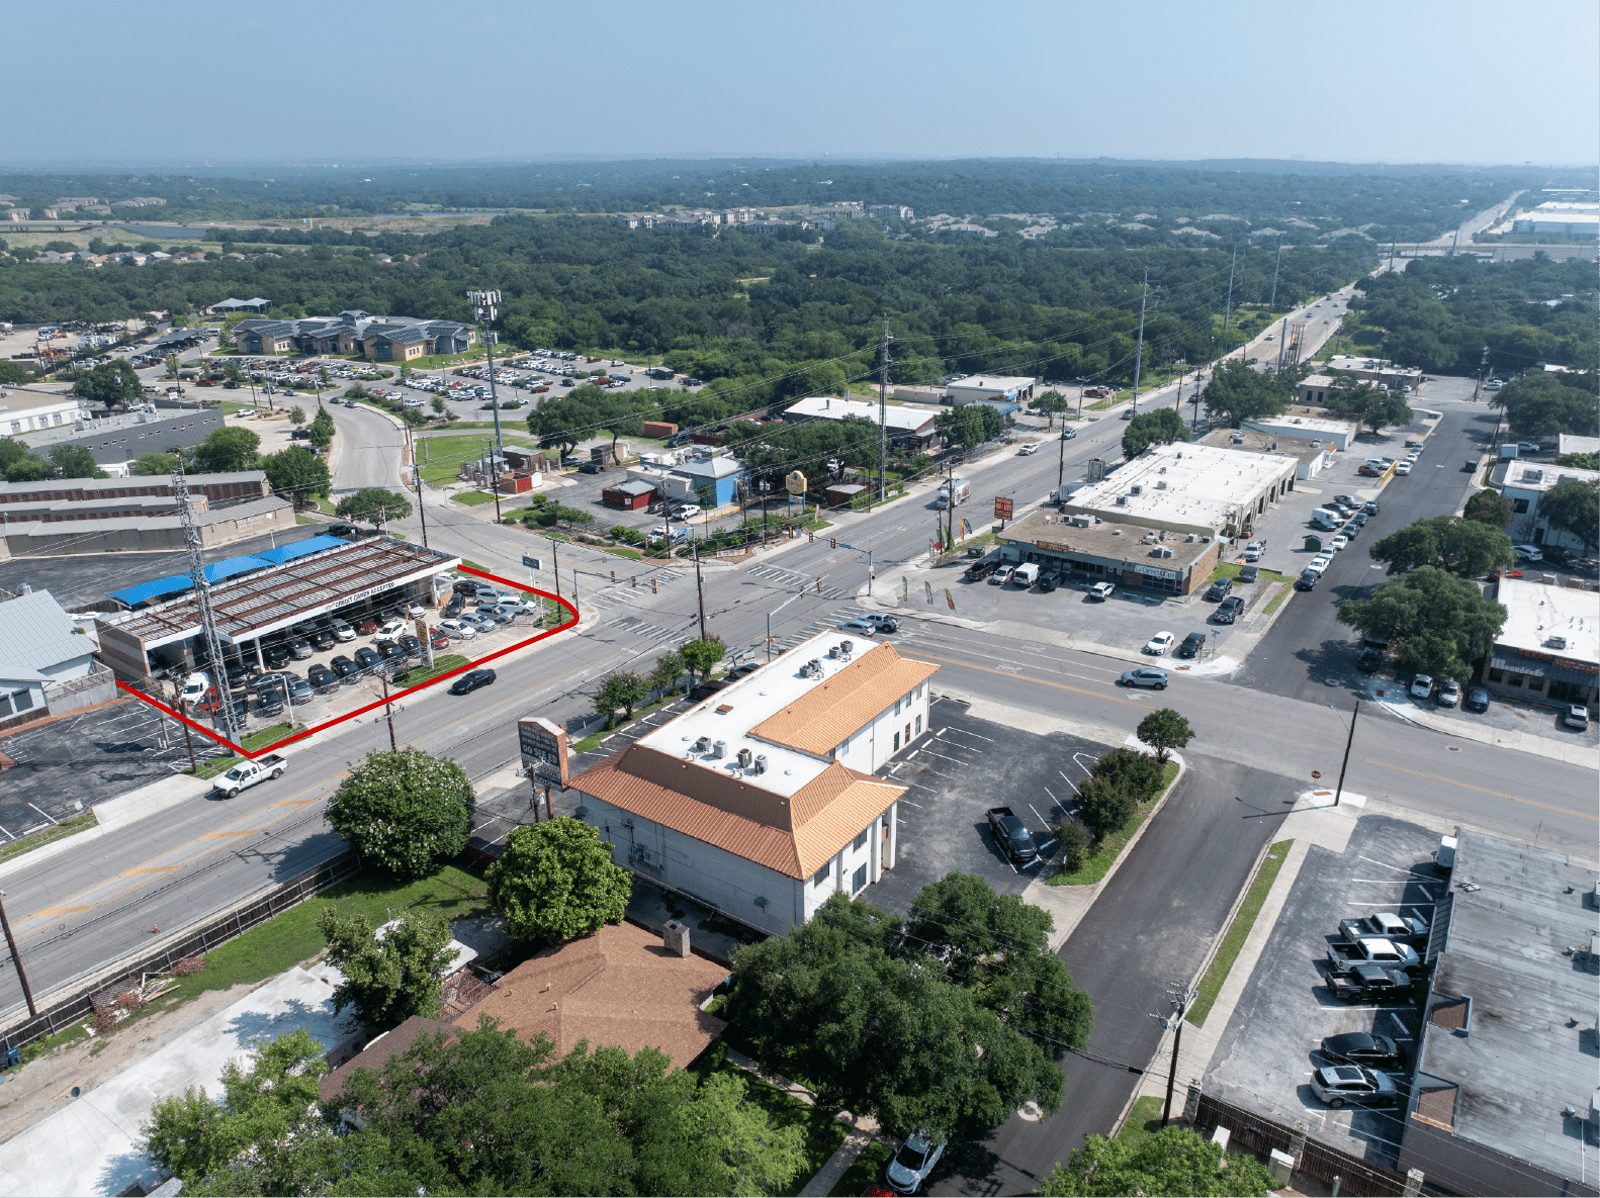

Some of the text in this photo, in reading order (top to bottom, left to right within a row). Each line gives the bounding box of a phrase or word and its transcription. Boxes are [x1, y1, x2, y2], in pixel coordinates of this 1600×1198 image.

[335, 597, 353, 607] CREDIT
[371, 582, 395, 594] ACCEPTED
[522, 744, 533, 754] GO
[533, 748, 547, 760] SEE
[547, 753, 558, 764] ED
